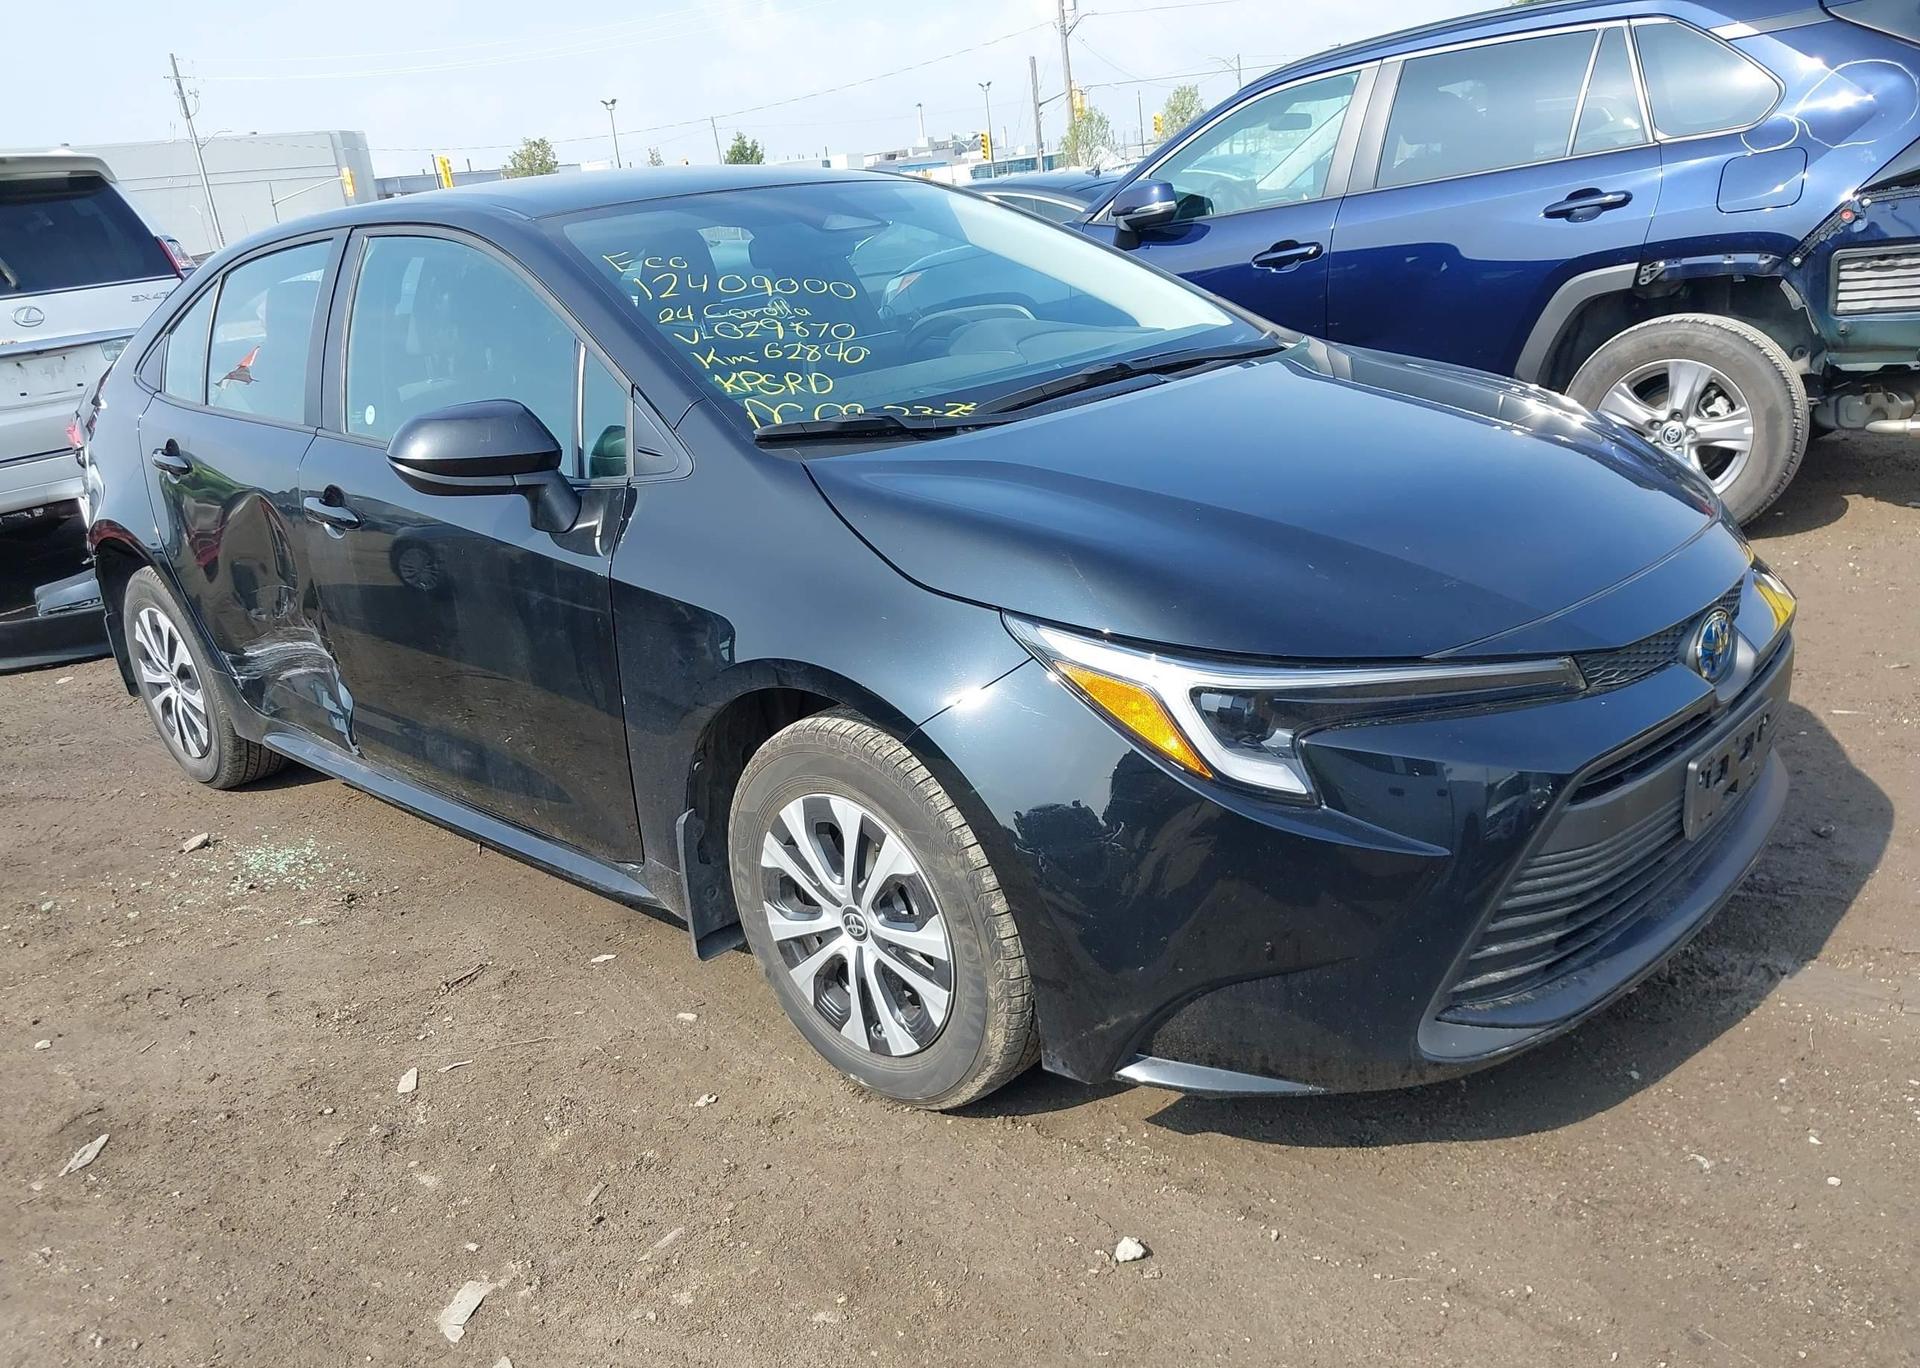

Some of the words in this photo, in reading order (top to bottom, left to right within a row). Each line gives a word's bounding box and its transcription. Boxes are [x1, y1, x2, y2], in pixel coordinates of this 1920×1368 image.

[602, 251, 688, 273] Eco
[632, 271, 858, 300] 12409000
[703, 298, 813, 319] Corolla
[764, 341, 872, 364] 62840
